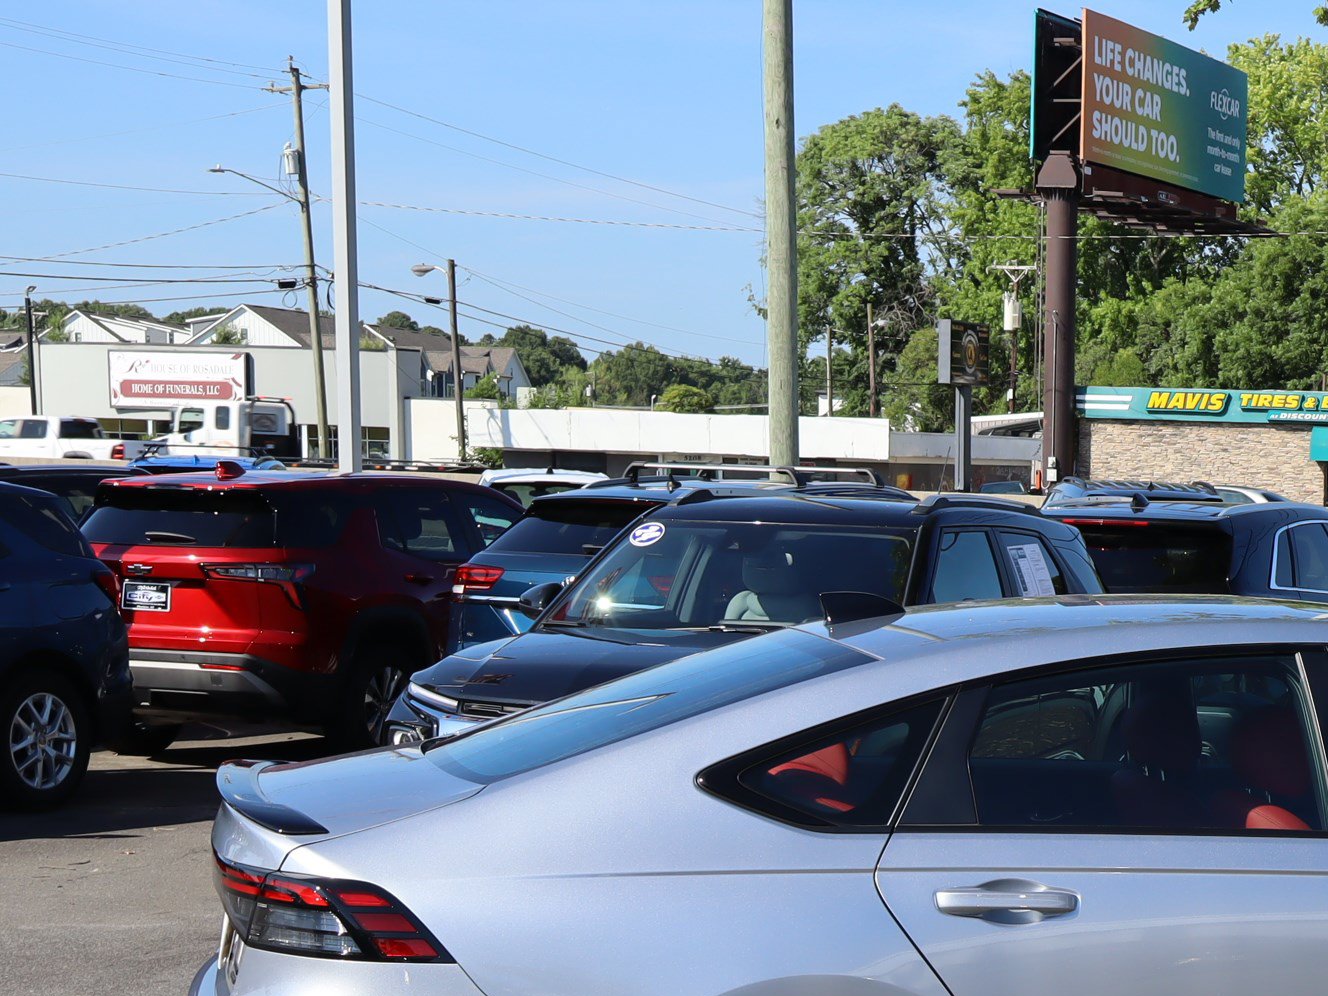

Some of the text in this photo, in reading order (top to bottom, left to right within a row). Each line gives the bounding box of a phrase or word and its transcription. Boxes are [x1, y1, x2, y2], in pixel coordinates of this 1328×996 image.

[1094, 35, 1190, 97] LIFE CHANGES.
[1093, 72, 1161, 122] YOUR CAR
[1210, 90, 1240, 118] FLEXCAR
[1092, 110, 1180, 163] SHOULD TOO.
[151, 363, 233, 375] HOUSE OF ROSADALE
[131, 383, 220, 396] HOME OF FUNERALS, LLC
[1147, 391, 1229, 411] MAVIS
[1240, 393, 1301, 409] TIRES
[1303, 396, 1318, 409] &
[128, 592, 153, 602] City
